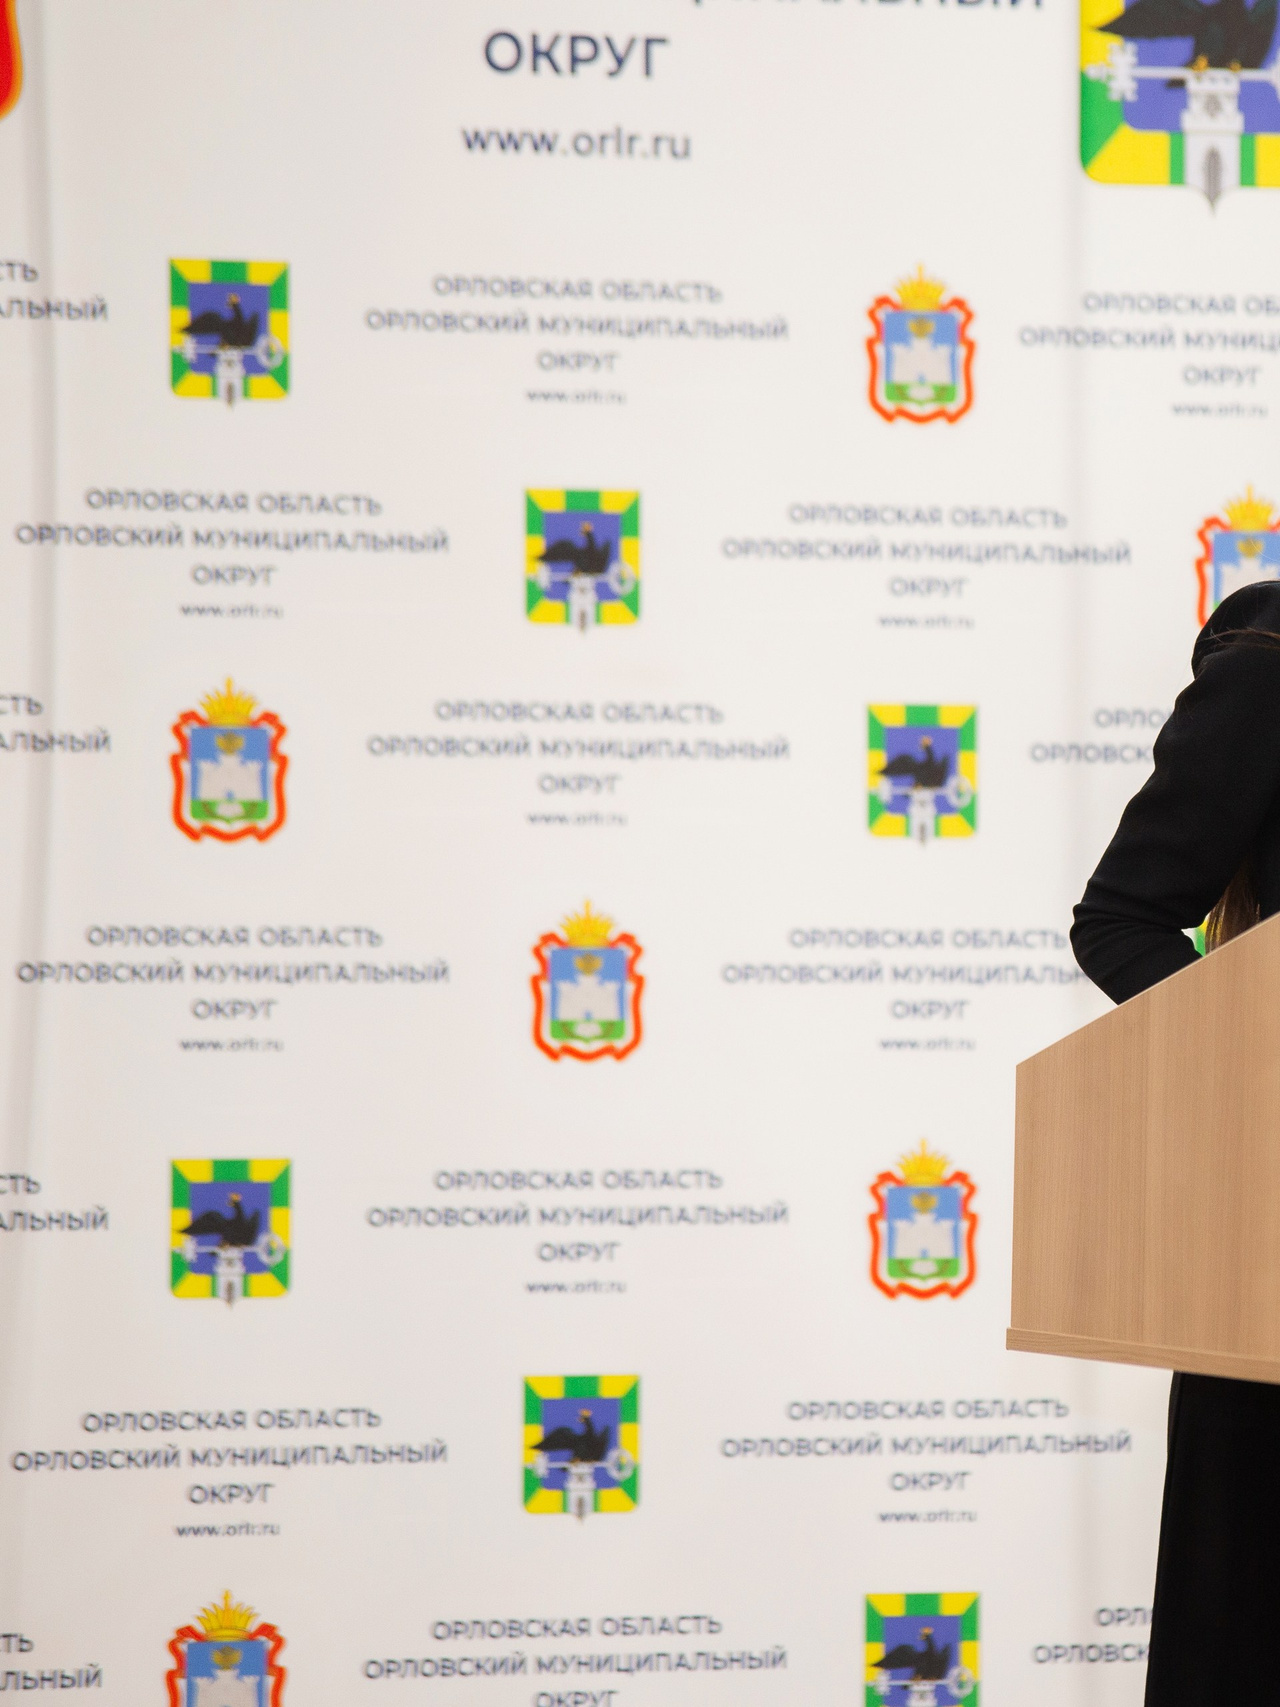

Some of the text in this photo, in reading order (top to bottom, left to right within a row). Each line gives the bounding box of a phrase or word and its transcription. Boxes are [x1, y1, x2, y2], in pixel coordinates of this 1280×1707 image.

[483, 30, 669, 78] ОКРУГ
[461, 126, 691, 160] www.orlr.ru
[431, 274, 723, 304] ОРЛОВСКАЯ ОБЛАСТЬ
[1079, 291, 1236, 315] ОРЛОВСКАЯ
[364, 308, 788, 340] ОРЛОВСКИЙ МУНИЦИПАЛЬНЫЙ
[1018, 325, 1176, 350] ОРЛОВСКИЙ
[536, 350, 618, 372] ОКРУГ
[1182, 364, 1262, 387] ОКРУГ
[85, 488, 382, 516] ОРЛОВСКАЯ ОБЛАСТЬ
[787, 503, 1069, 529] ОРЛОВСКАЯ ОБЛАСТЬ
[14, 519, 449, 553] ОРЛОВСКИЙ МУНИЦИПАЛЬНЫЙ
[721, 538, 1131, 565] ОРЛОВСКИЙ МУНИЦИПАЛЬНЫЙ
[191, 564, 277, 586] ОКРУГ
[888, 576, 967, 597] ОКРУГ
[433, 700, 724, 724] ОРЛОВСКАЯ ОБЛАСТЬ
[366, 733, 790, 761] ОРЛОВСКИЙ МУНИЦИПАЛЬНЫЙ
[537, 773, 620, 795] ОКРУГ
[85, 925, 383, 947] ОРЛОВСКАЯ ОБЛАСТЬ
[788, 928, 1067, 950] ОРЛОВСКАЯ ОБЛАСТЬ
[15, 958, 449, 985] ОРЛОВСКИЙ МУНИЦИПАЛЬНЫЙ
[721, 960, 884, 984] ОРЛОВСКИЙ
[191, 997, 278, 1019] ОКРУГ
[889, 999, 969, 1020] ОКРУГ
[433, 1169, 723, 1191] ОРЛОВСКАЯ ОБЛАСТЬ
[366, 1201, 788, 1228] ОРЛОВСКИЙ МУНИЦИПАЛЬНЫЙ
[535, 1241, 621, 1263] ОКРУГ
[80, 1407, 382, 1433] ОРЛОВСКАЯ ОБЛАСТЬ
[786, 1398, 1070, 1421] ОРЛОВСКАЯ ОБЛАСТЬ
[10, 1438, 447, 1472] ОРЛОВСКИЙ МУНИЦИПАЛЬНЫЙ
[720, 1430, 1131, 1458] ОРЛОВСКИЙ МУНИЦИПАЛЬНЫЙ
[888, 1470, 972, 1492] ОКРУГ
[186, 1482, 275, 1506] ОКРУГ
[430, 1615, 722, 1641] ОРЛОВСКАЯ ОБЛАСТЬ
[362, 1645, 787, 1680] ОРЛОВСКИЙ МУНИЦИПАЛЬНЫЙ
[532, 1689, 619, 1707] ОКРУГ
